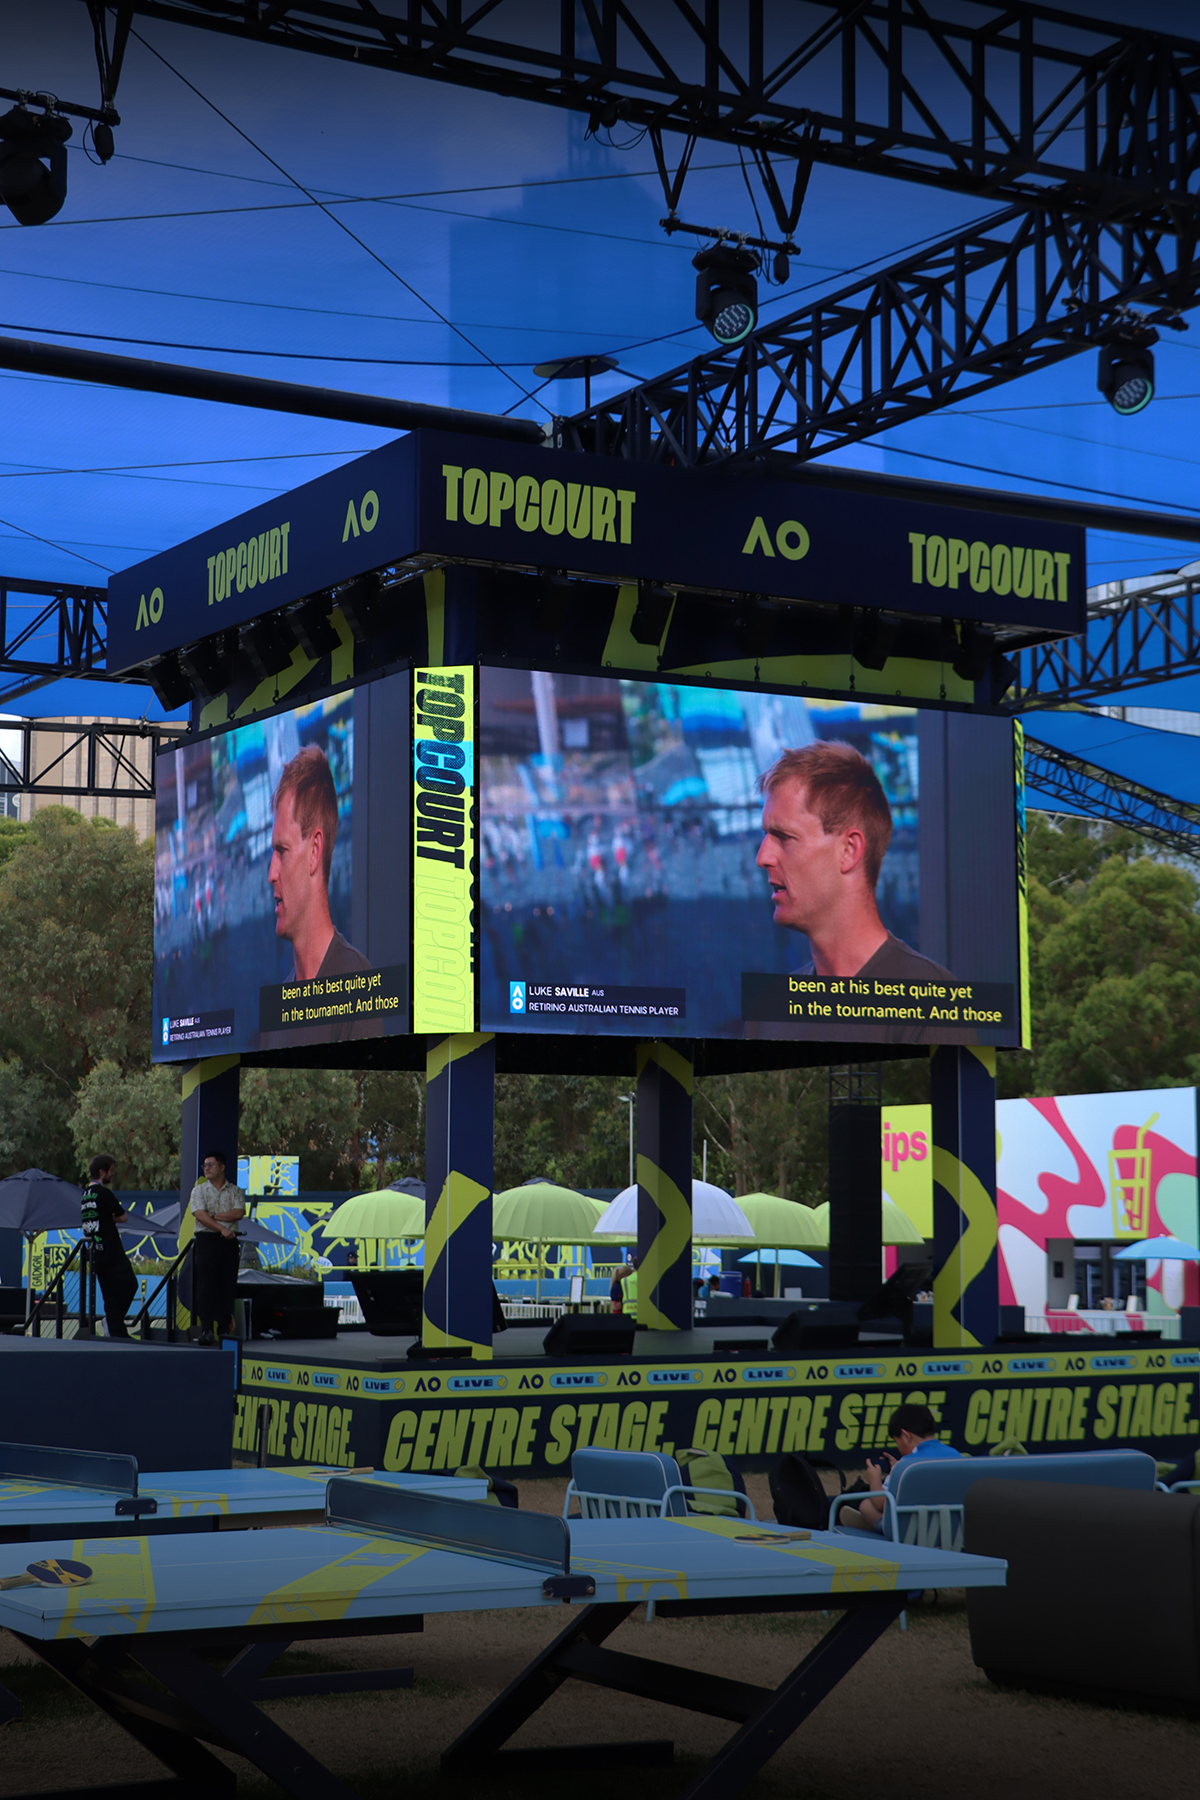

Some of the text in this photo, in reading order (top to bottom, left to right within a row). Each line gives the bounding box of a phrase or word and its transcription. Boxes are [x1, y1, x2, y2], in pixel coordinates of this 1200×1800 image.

[442, 464, 1071, 602] TOPCOURT AO TOPCOURT
[135, 489, 380, 631] AO TOPCOURT AO
[416, 671, 466, 870] TOPCOURT
[281, 973, 382, 1000] been at his best quite yet
[529, 986, 605, 997] LUKE SAVILLE AUS
[788, 977, 972, 1001] been at his best quite yet
[281, 995, 399, 1022] in the tournament. And those
[529, 1002, 679, 1016] RETIRING AUSTRALIAN TENNIS PLAYER
[788, 1000, 1002, 1022] in the tournament. And those
[882, 1122, 928, 1171] ips
[251, 1366, 391, 1391] AO LIVE AO LIVE AO LIVE
[414, 1354, 1200, 1392] AO LIVE AO LIVE AO LIVE AO LIVE AO LIVE AO LIVE AO LIVE AO LIVE AO LIV
[290, 1401, 356, 1467] STAGE.
[691, 1395, 832, 1456] CENTRE
[964, 1382, 1200, 1446] CENTRE STAGE.
[383, 1400, 675, 1472] CENTRE STAGE.
